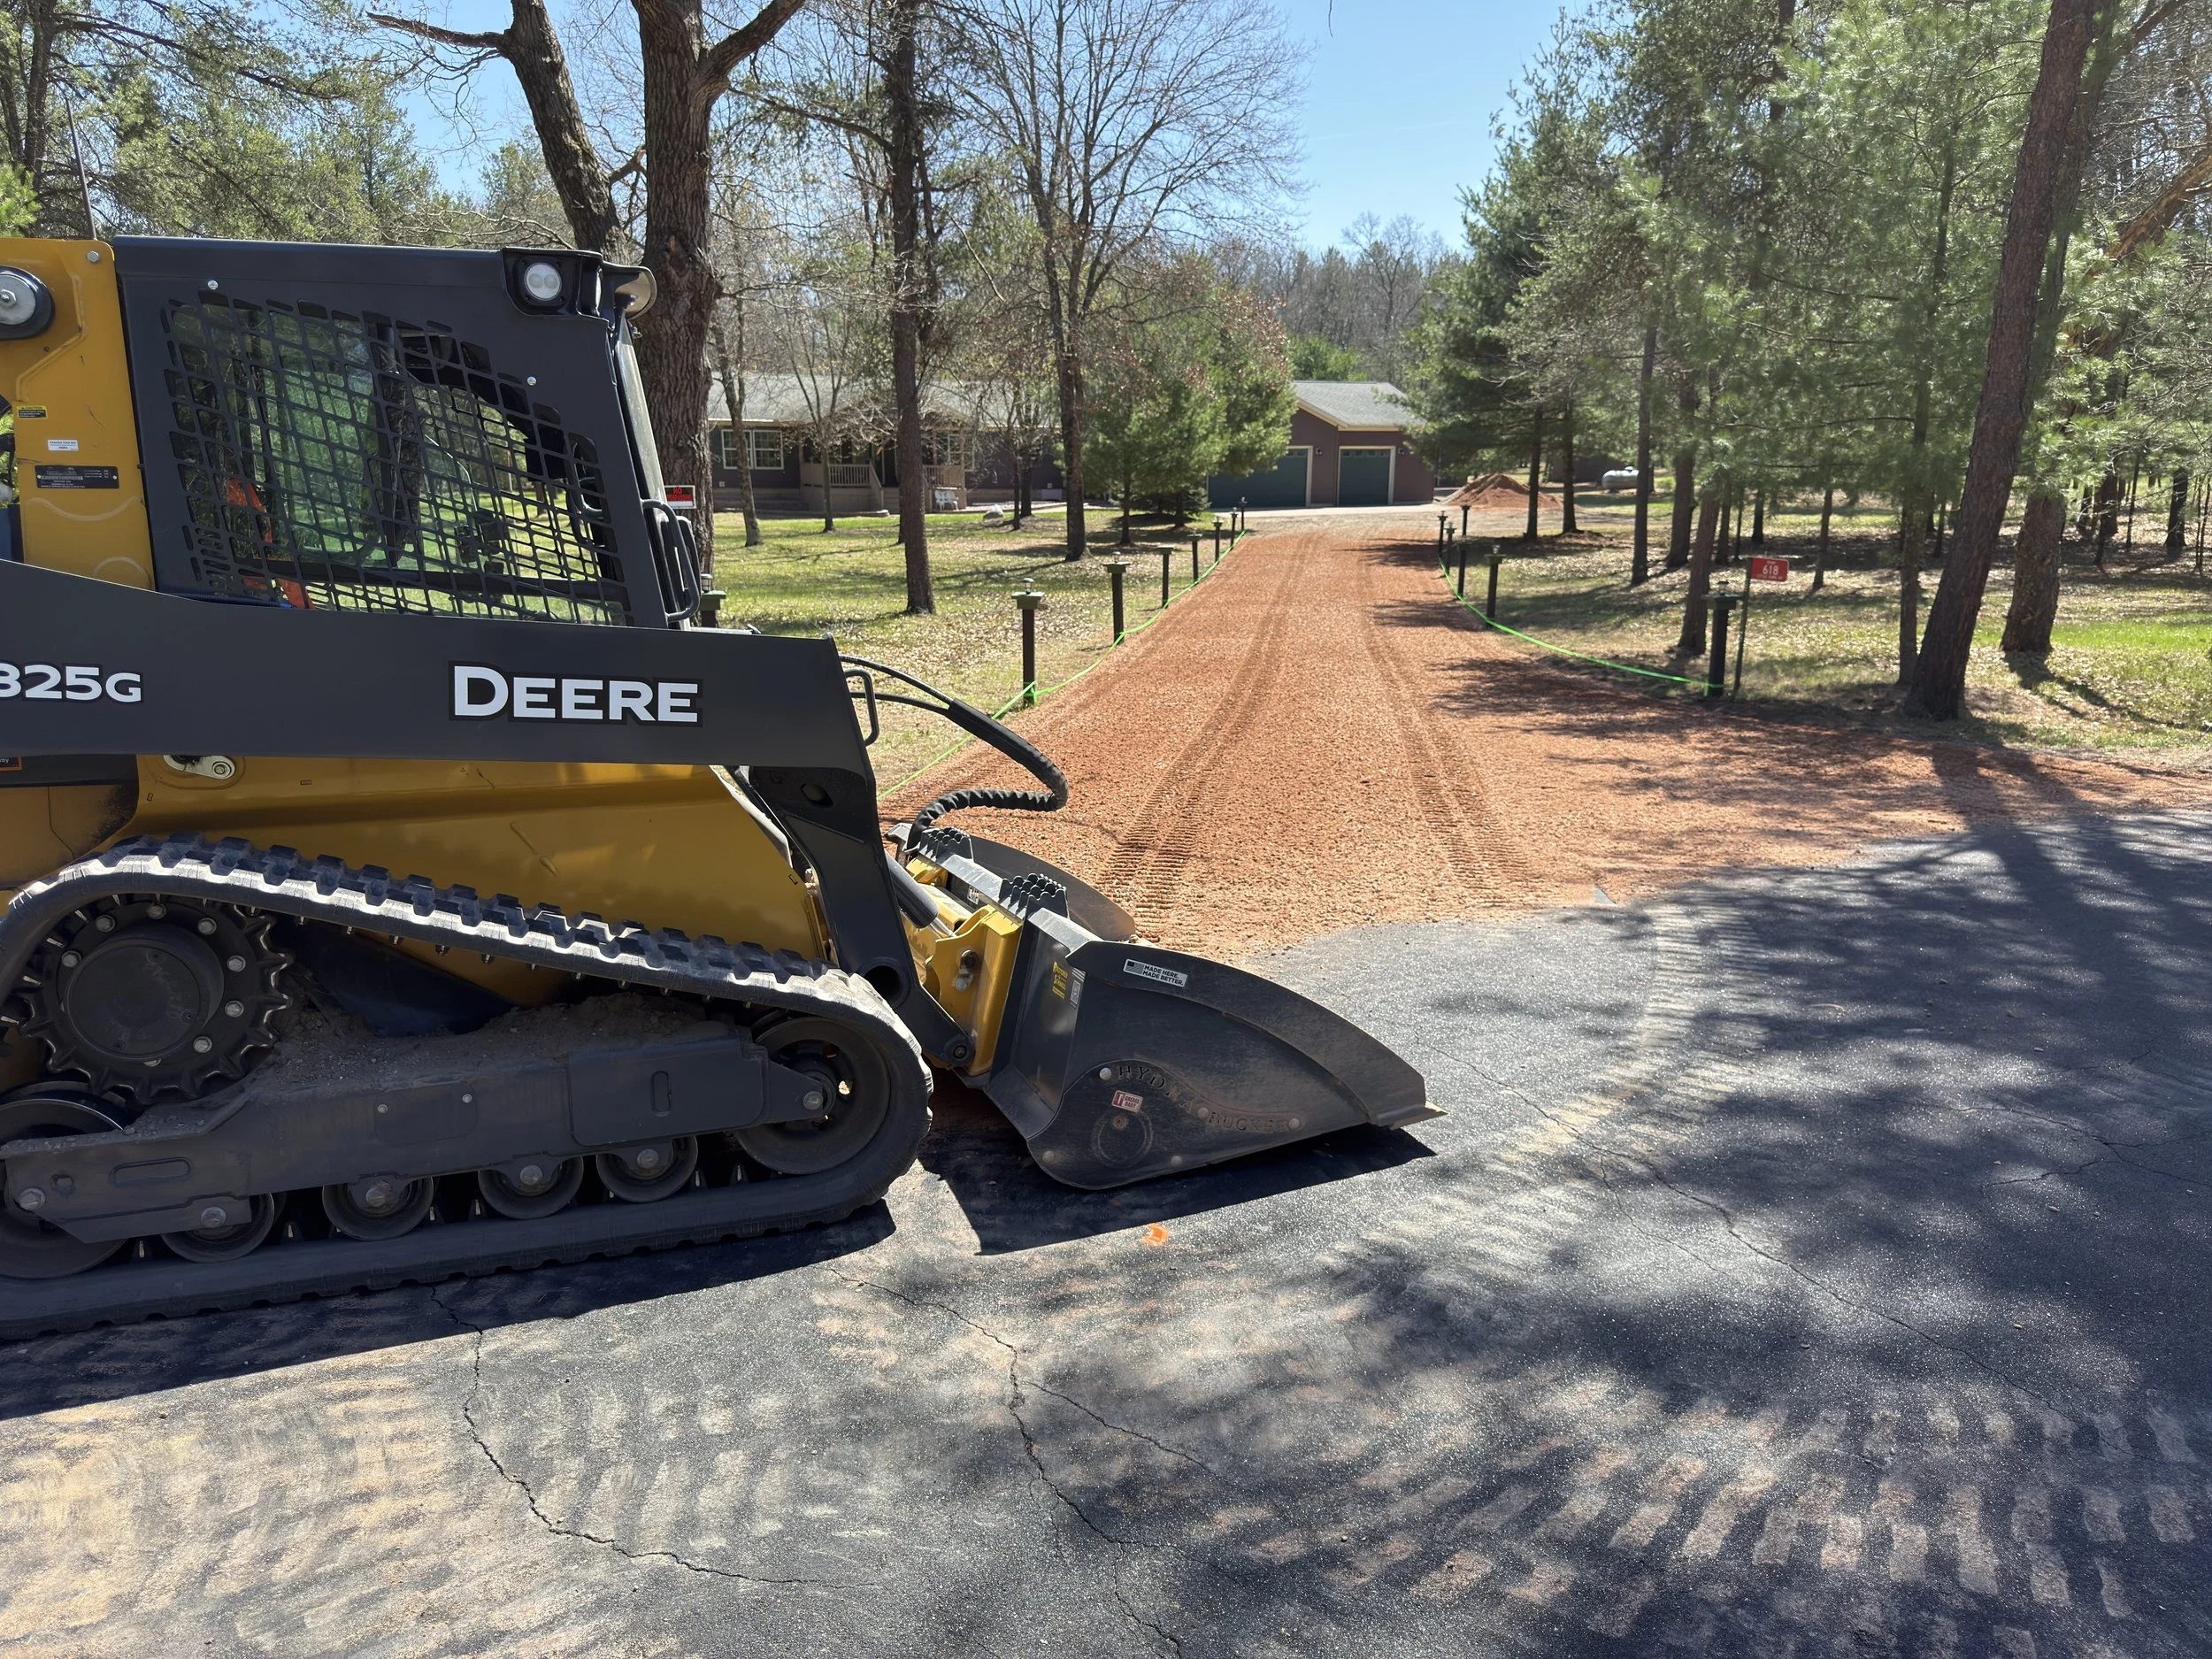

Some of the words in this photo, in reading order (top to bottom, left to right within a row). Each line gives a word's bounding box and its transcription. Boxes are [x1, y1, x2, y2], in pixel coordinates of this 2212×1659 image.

[1763, 565, 1778, 576] 618
[454, 665, 698, 723] DEERE
[1142, 971, 1160, 979] MADE
[1161, 975, 1184, 986] BETTER.
[1144, 965, 1162, 974] MADE
[1163, 970, 1179, 979] HERE.
